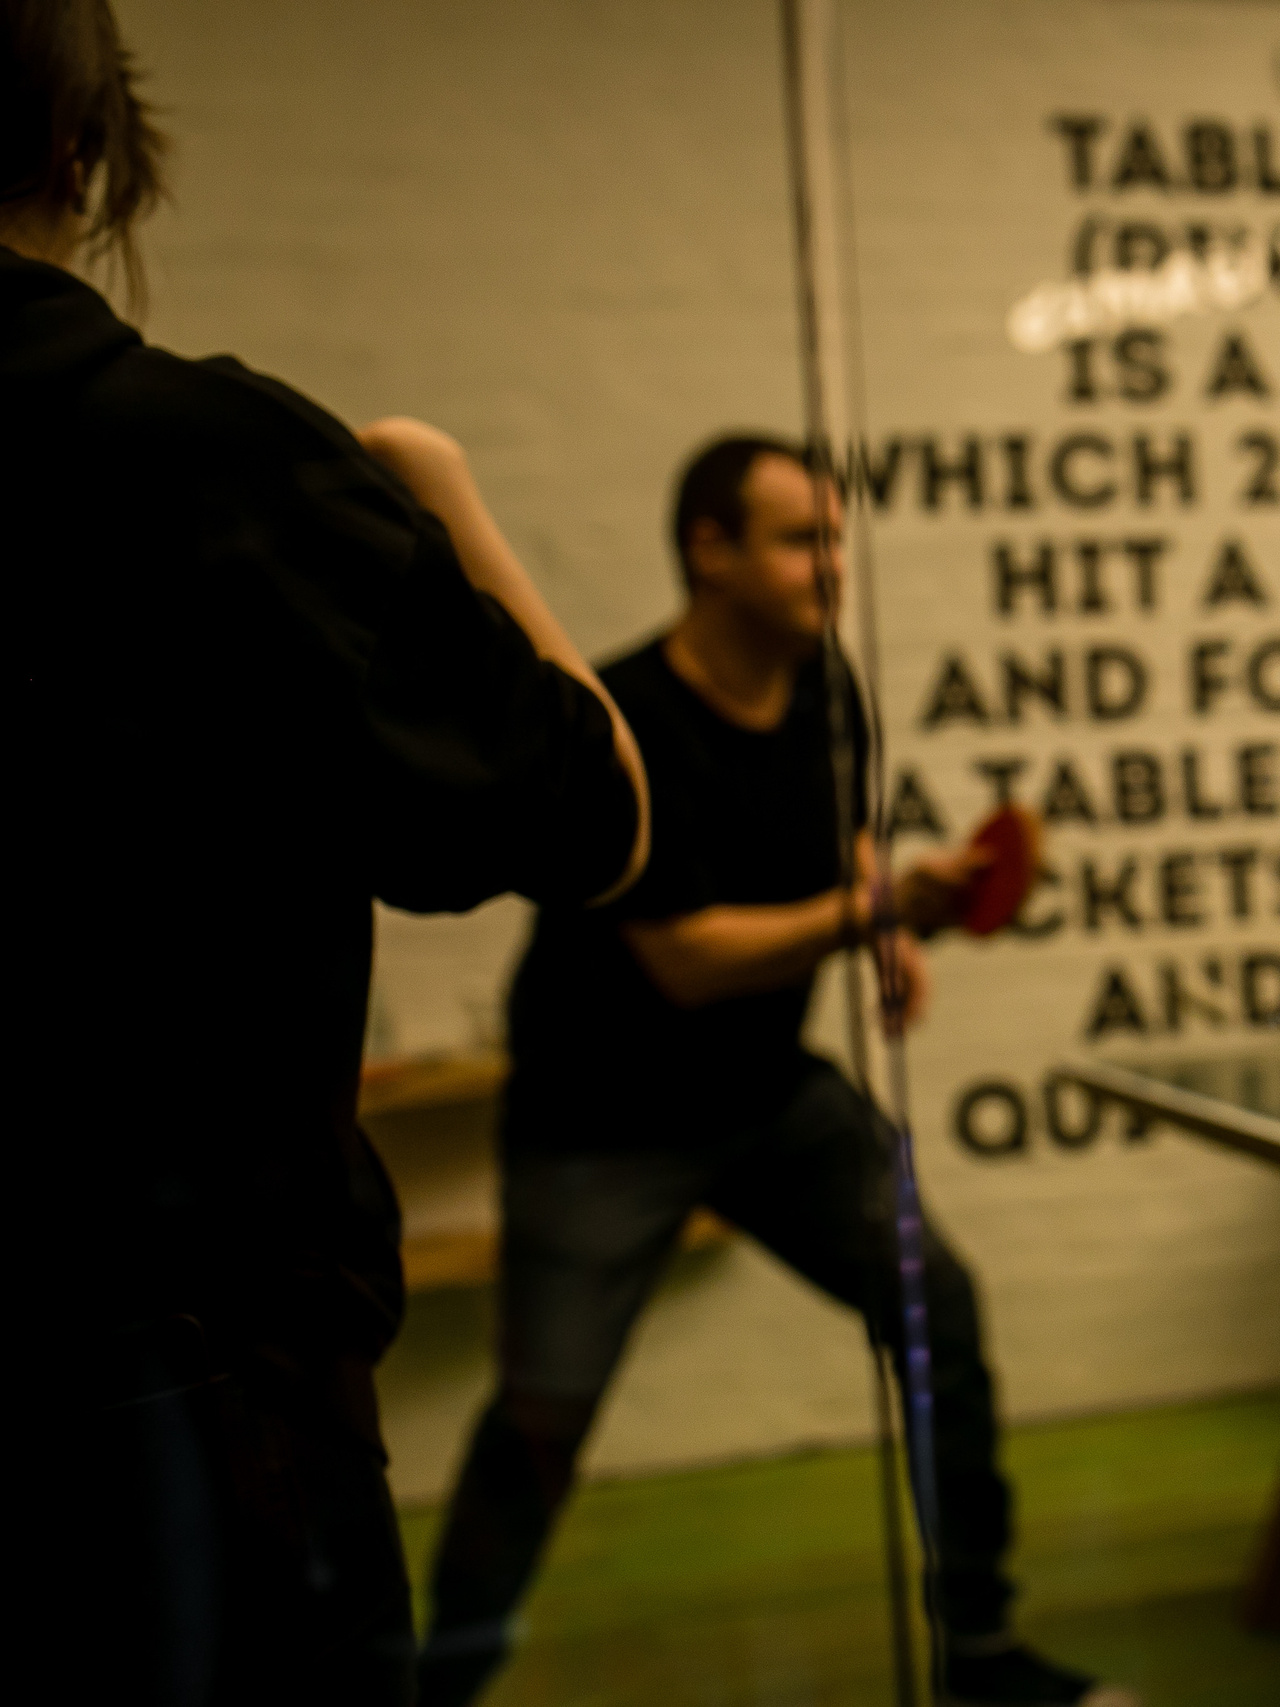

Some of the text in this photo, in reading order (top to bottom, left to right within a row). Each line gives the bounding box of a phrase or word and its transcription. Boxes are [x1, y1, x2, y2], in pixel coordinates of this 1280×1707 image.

[1066, 325, 1172, 405] IS
[1206, 330, 1272, 404] A
[995, 538, 1170, 612] HIT
[1203, 540, 1268, 606] A
[922, 648, 1148, 732] AND
[887, 768, 946, 842] A
